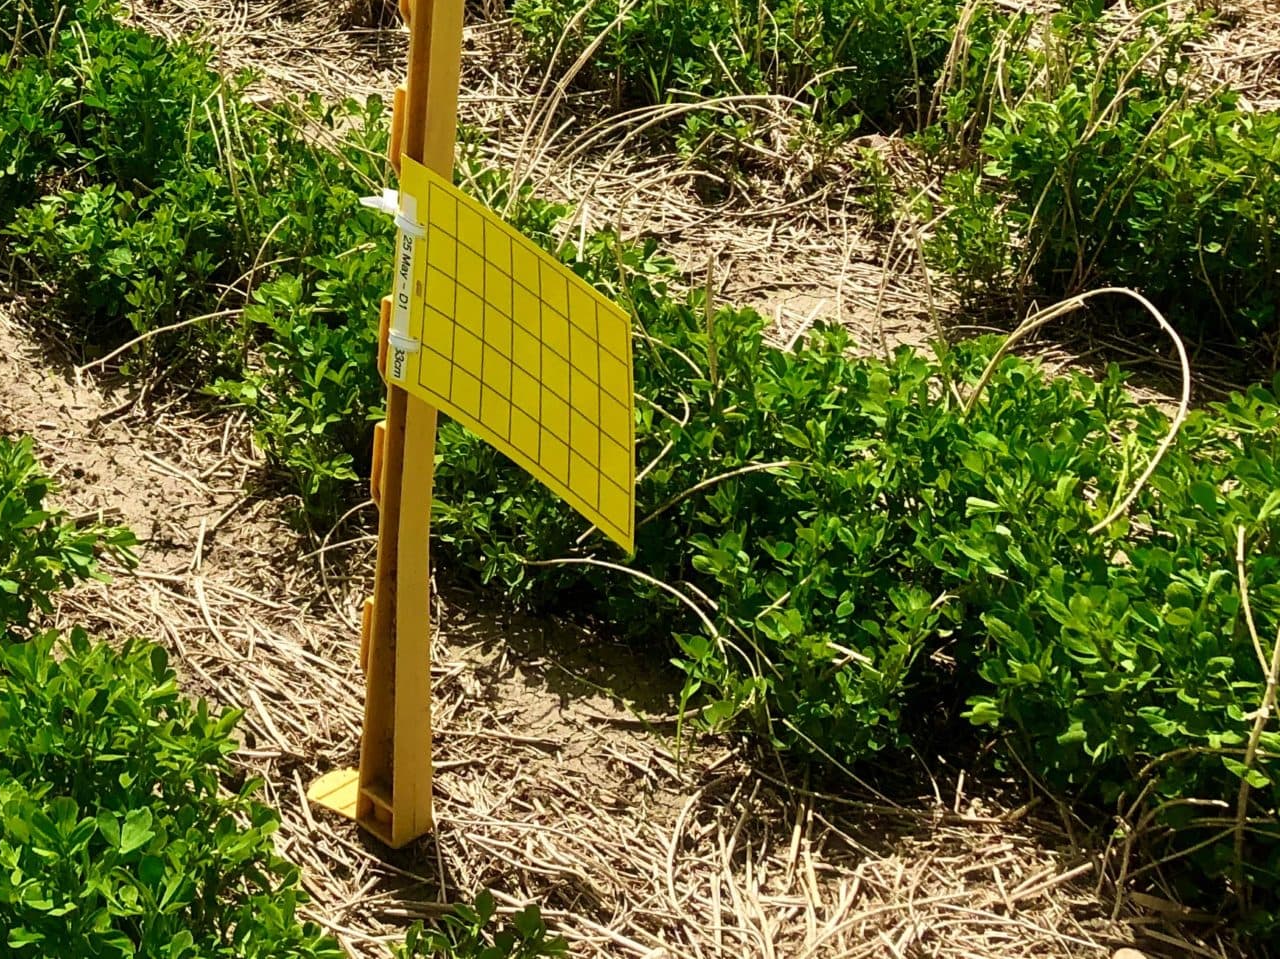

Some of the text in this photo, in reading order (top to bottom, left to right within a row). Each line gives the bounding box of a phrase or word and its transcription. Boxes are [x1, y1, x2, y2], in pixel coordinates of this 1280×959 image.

[402, 234, 413, 252] 25
[400, 253, 412, 280] May
[399, 293, 409, 310] D1
[393, 346, 406, 379] 33cm
